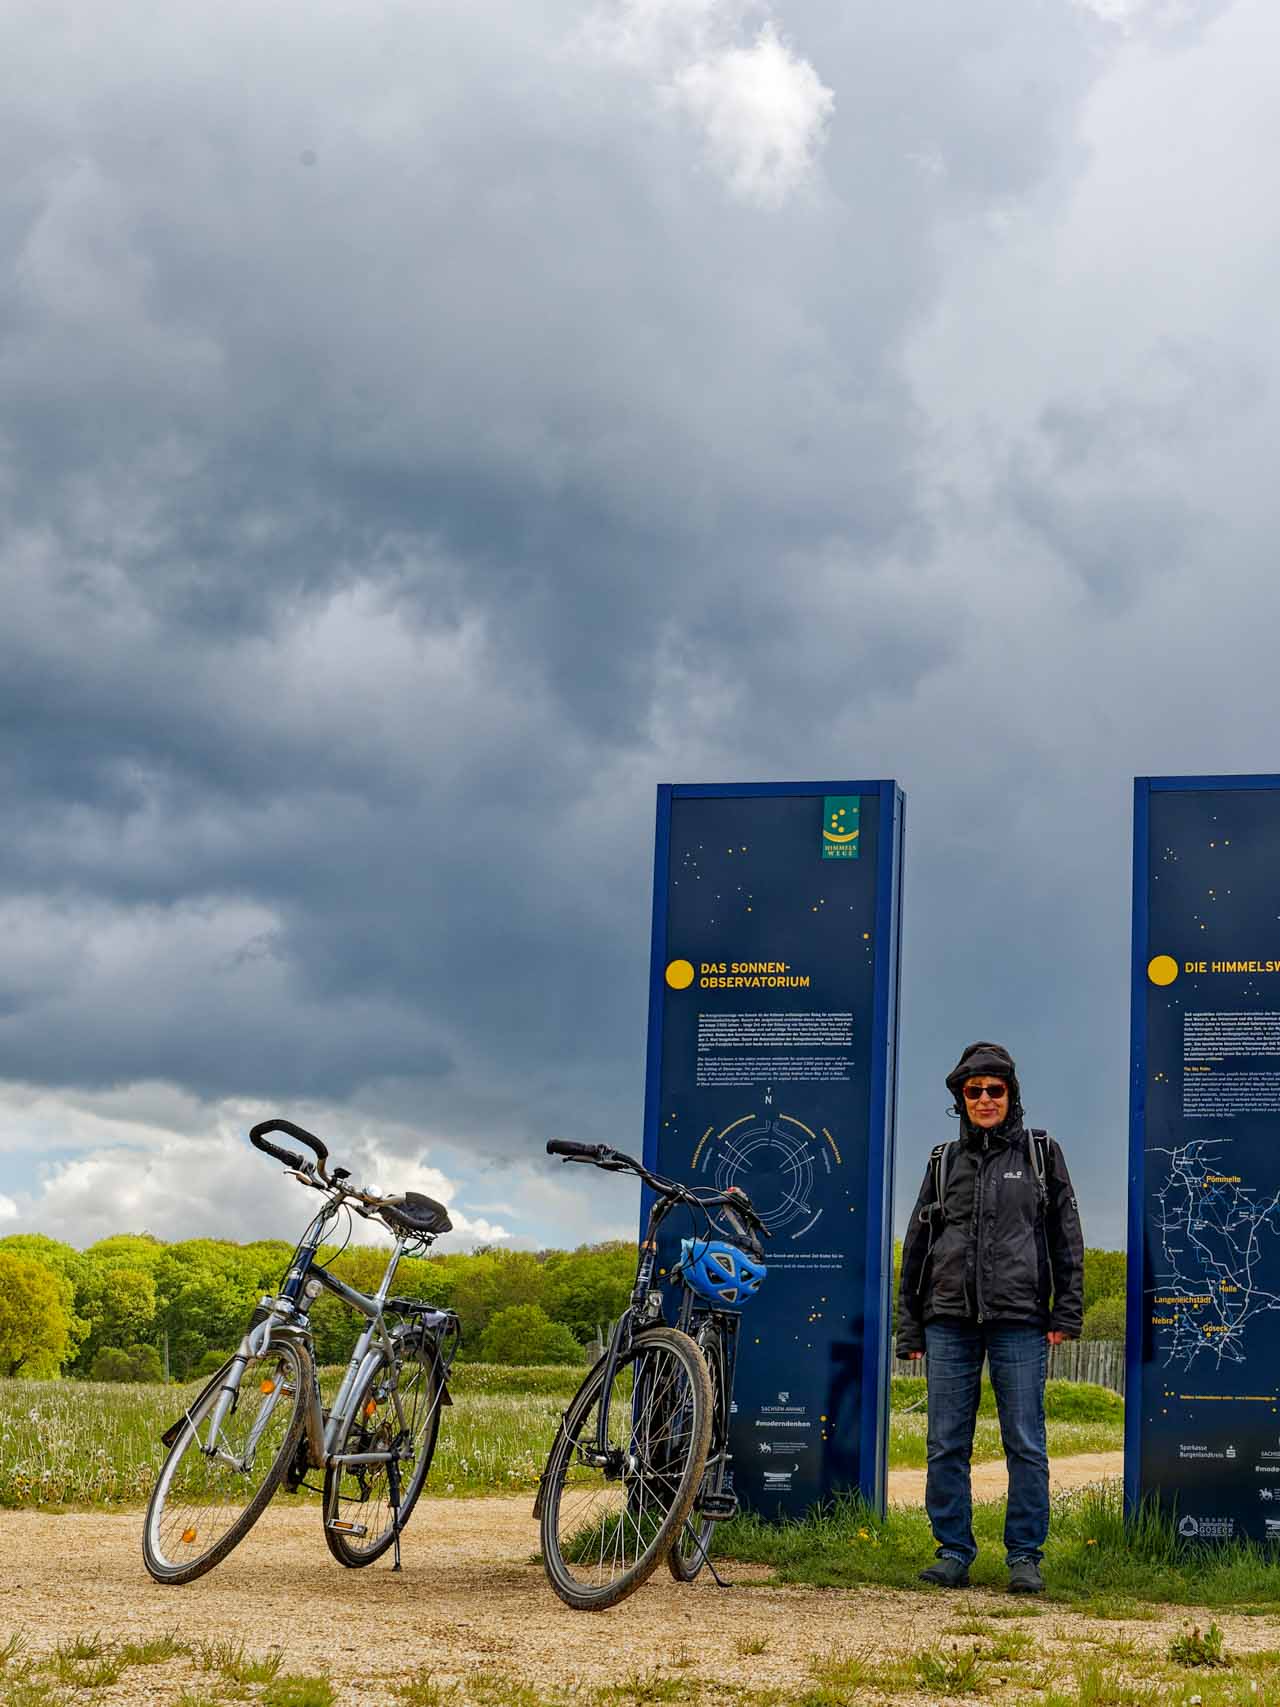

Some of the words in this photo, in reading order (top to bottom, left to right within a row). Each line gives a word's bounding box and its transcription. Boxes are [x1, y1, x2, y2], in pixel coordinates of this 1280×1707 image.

[701, 963, 727, 974] DAS
[731, 962, 791, 974] SONNEN-
[1185, 962, 1207, 973] DIE
[700, 976, 810, 988] OBSERVATORIUM
[765, 1095, 772, 1105] N
